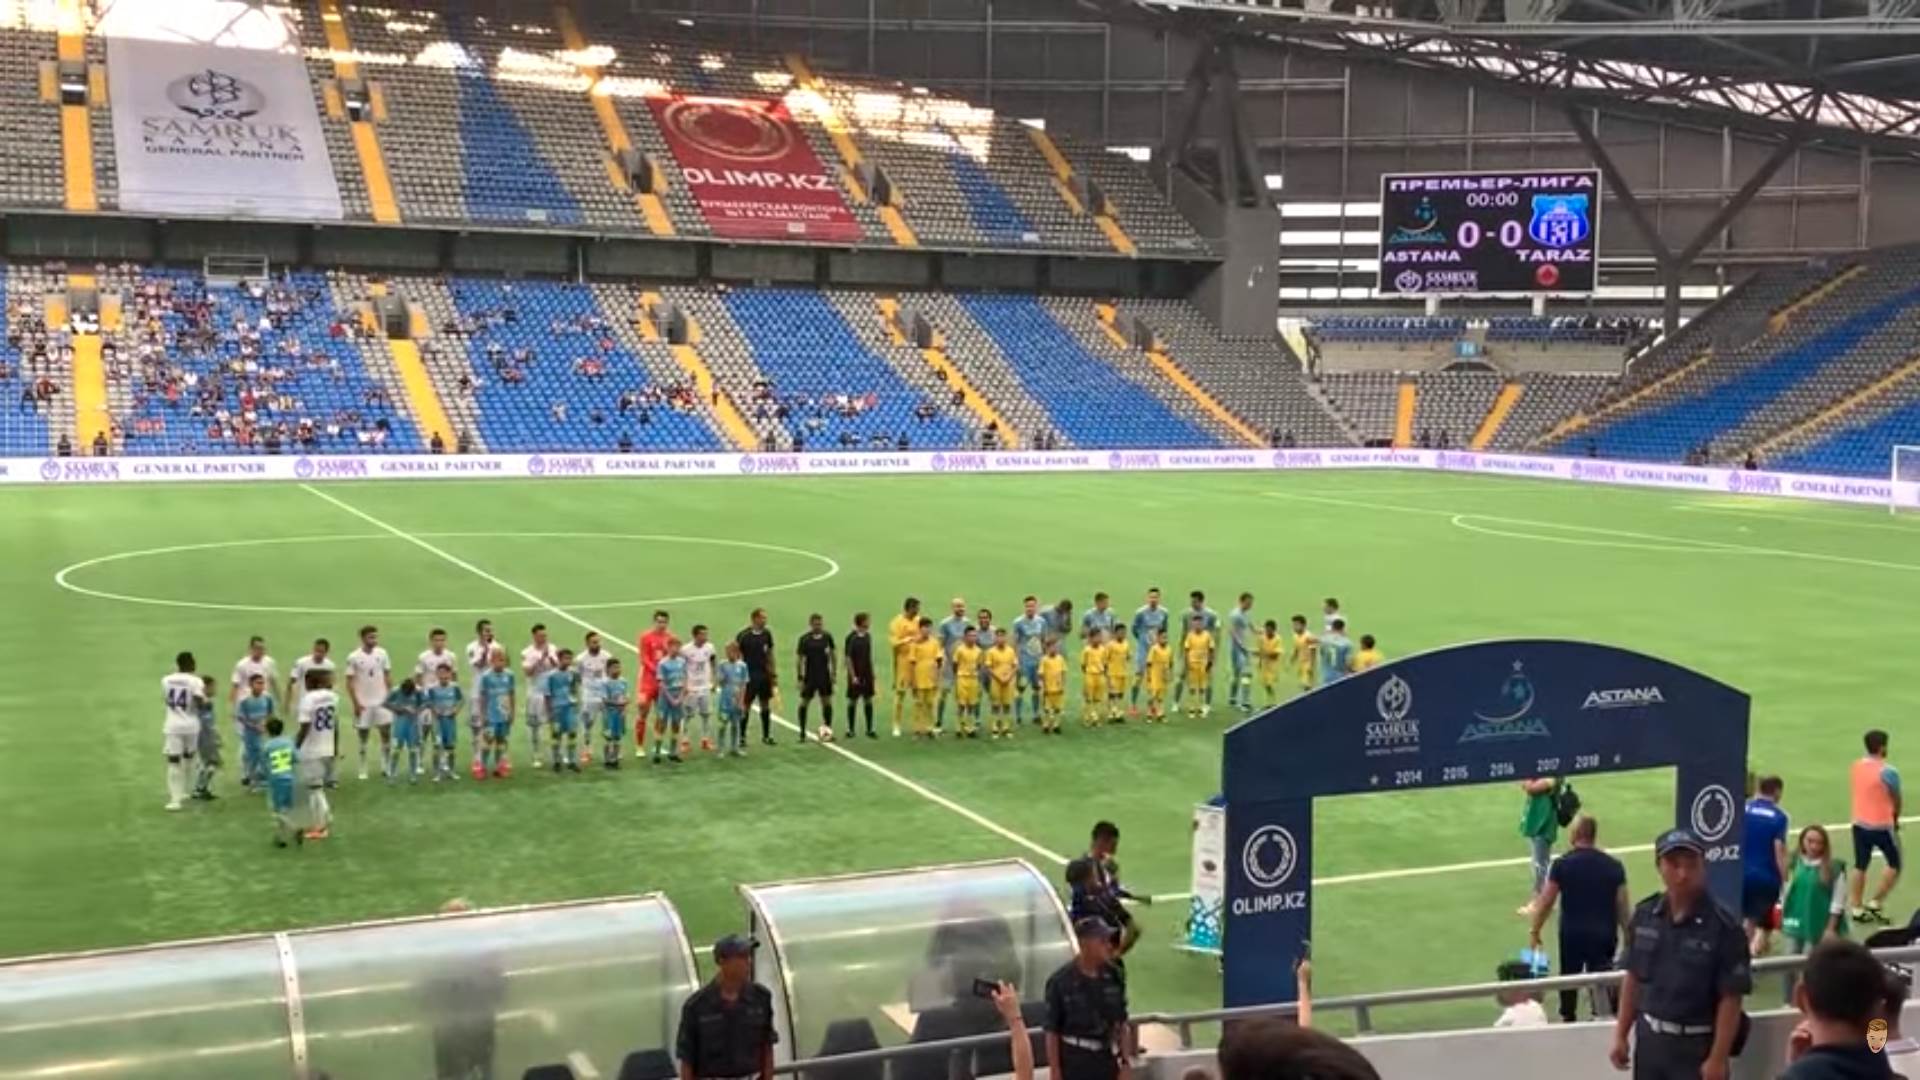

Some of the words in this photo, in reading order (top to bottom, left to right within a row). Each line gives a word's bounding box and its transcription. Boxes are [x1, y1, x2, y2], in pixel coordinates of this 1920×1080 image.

[142, 118, 301, 142] SAMRUK
[146, 145, 223, 157] GENERAL
[230, 149, 304, 161] PARTNER
[682, 167, 834, 191] OLIMP.KZ
[1390, 176, 1593, 191] ПРЕМЬЕР-ЛИГА
[1466, 192, 1519, 207] 00:00
[1457, 221, 1480, 248] 0
[1500, 220, 1523, 248] 0
[1384, 250, 1462, 262] ASTANA
[1516, 249, 1592, 262] TARAZ
[133, 462, 199, 474] GENERAL
[203, 462, 266, 473] PARTNER
[380, 460, 439, 472] GENERAL
[445, 460, 502, 471] PARTNER
[606, 459, 660, 470] GENERAL
[664, 459, 716, 469] PARTNER
[809, 457, 859, 468] GENERAL
[862, 457, 910, 467] PARTNER
[166, 687, 188, 711] 44
[1580, 686, 1665, 709] ASTANA
[1365, 720, 1420, 738] SAMRUK
[1457, 717, 1551, 743] ASTANA
[1395, 769, 1423, 784] 2014
[1443, 765, 1469, 780] 2015
[1489, 762, 1515, 777] 2016
[1536, 757, 1560, 772] 2017
[1575, 754, 1600, 769] 2018
[1232, 891, 1306, 915] OLIMP.KZ
